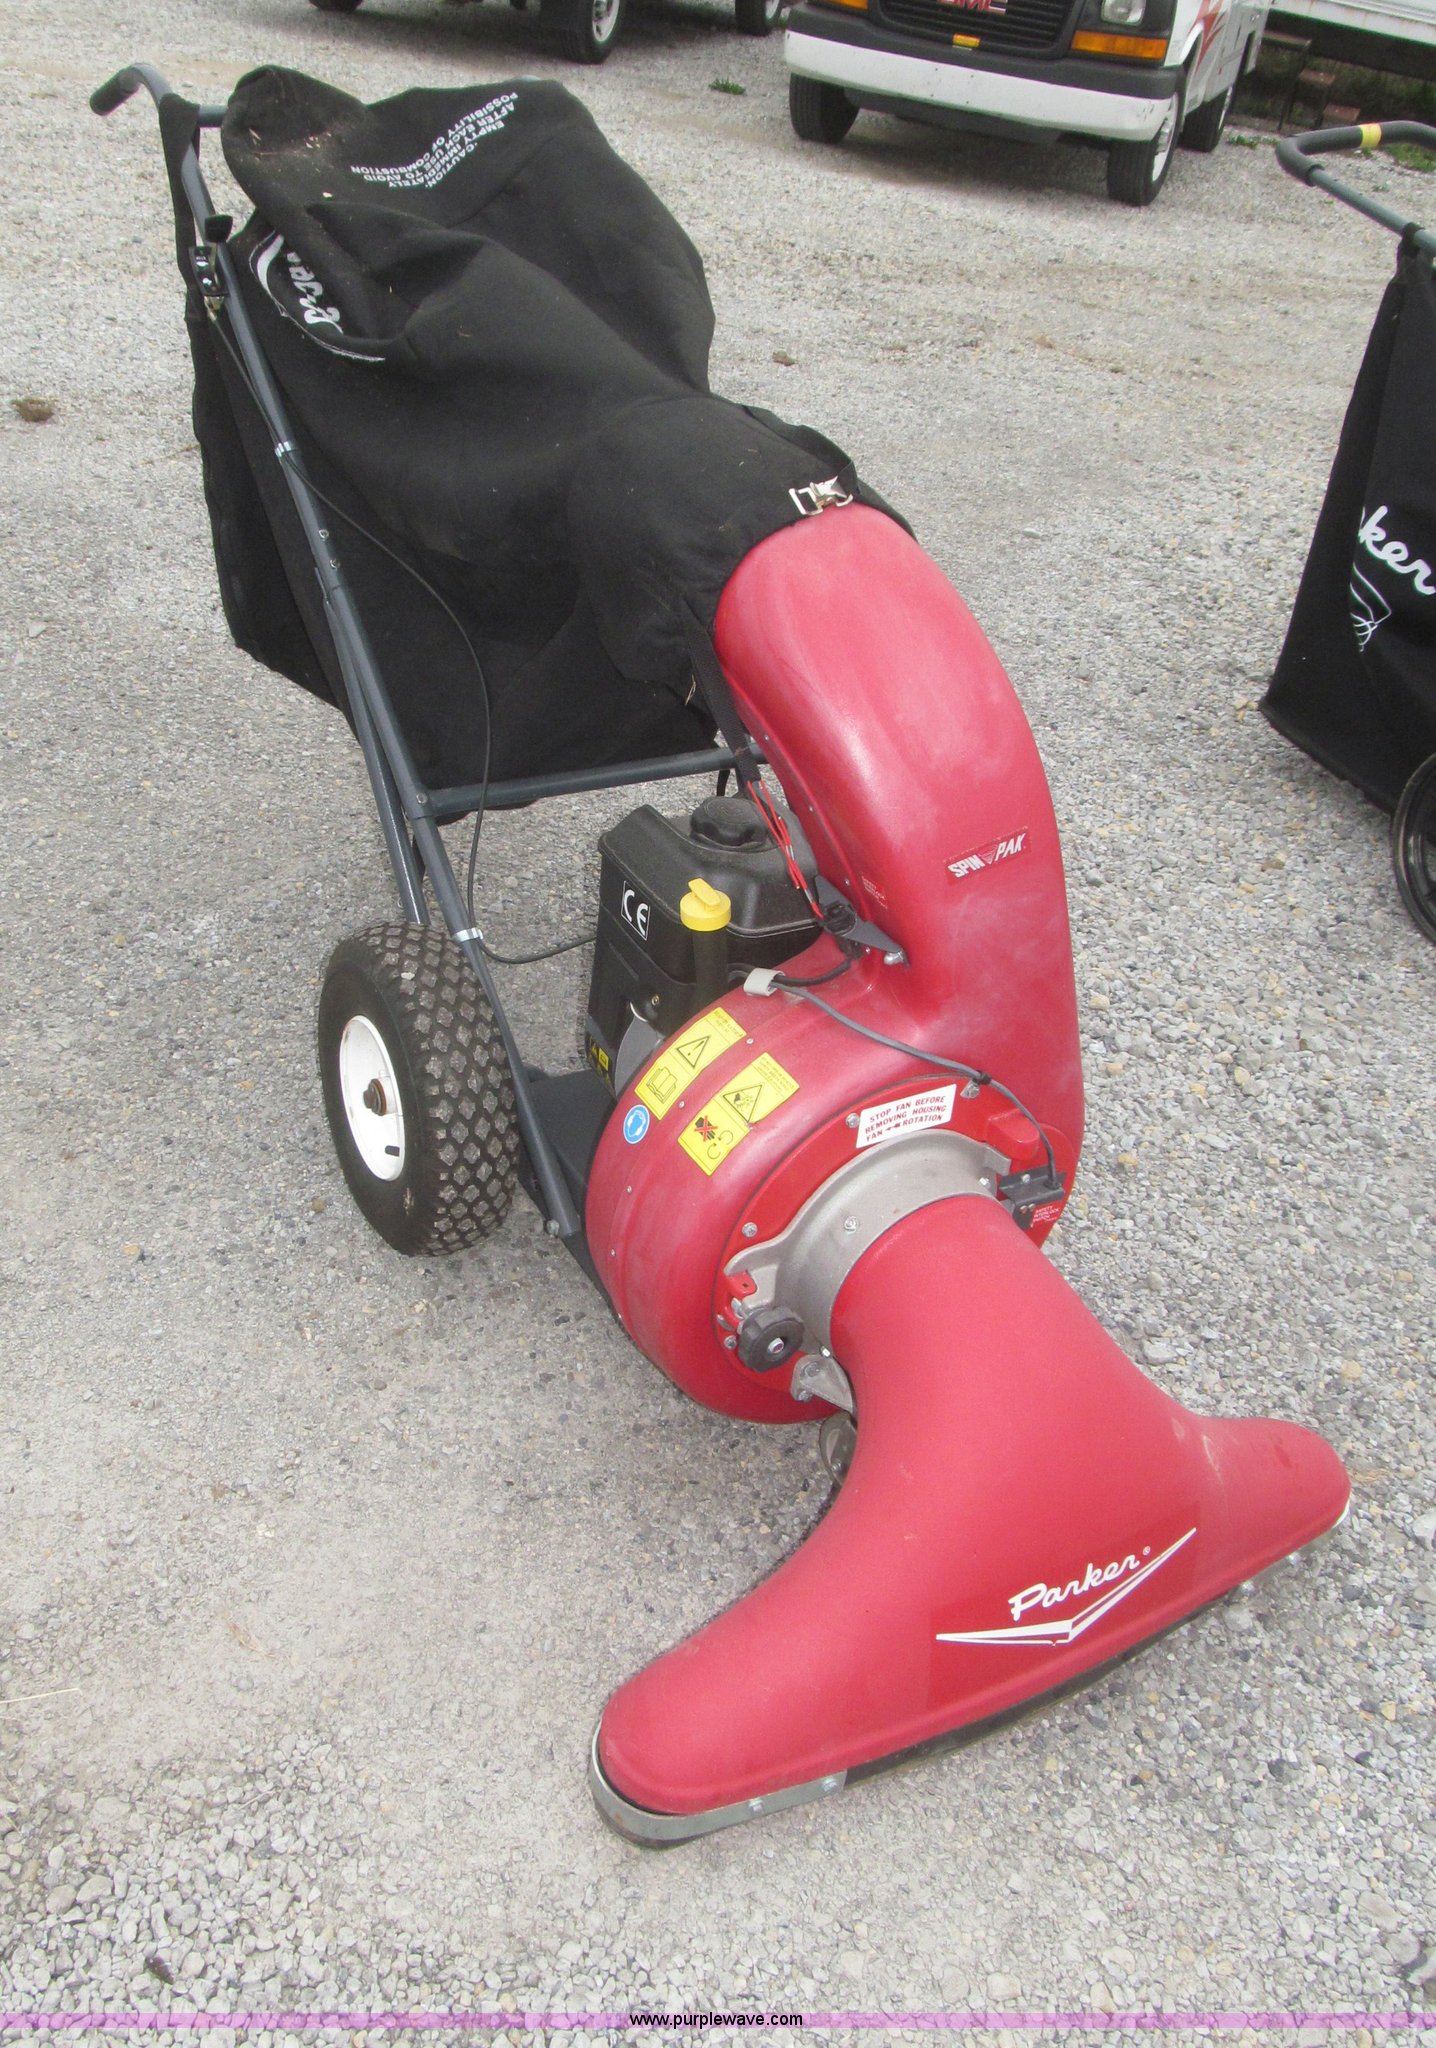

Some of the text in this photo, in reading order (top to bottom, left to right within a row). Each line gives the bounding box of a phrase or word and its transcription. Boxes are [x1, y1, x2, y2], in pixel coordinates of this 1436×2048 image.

[350, 92, 518, 175] POSSIBILITY OF COMBUSTION
[363, 102, 515, 182] AFTER EACH USE TO AVOID
[389, 120, 505, 188] EMPTY IMMEDIATELY
[947, 833, 1026, 878] SPIN PAK
[623, 889, 649, 937] CE
[865, 1105, 947, 1135] REMOVING HOUSING
[866, 1114, 944, 1142] FAN ROTATION
[869, 1095, 946, 1123] STOP FAN BEFORE
[1008, 1553, 1141, 1622] Parker
